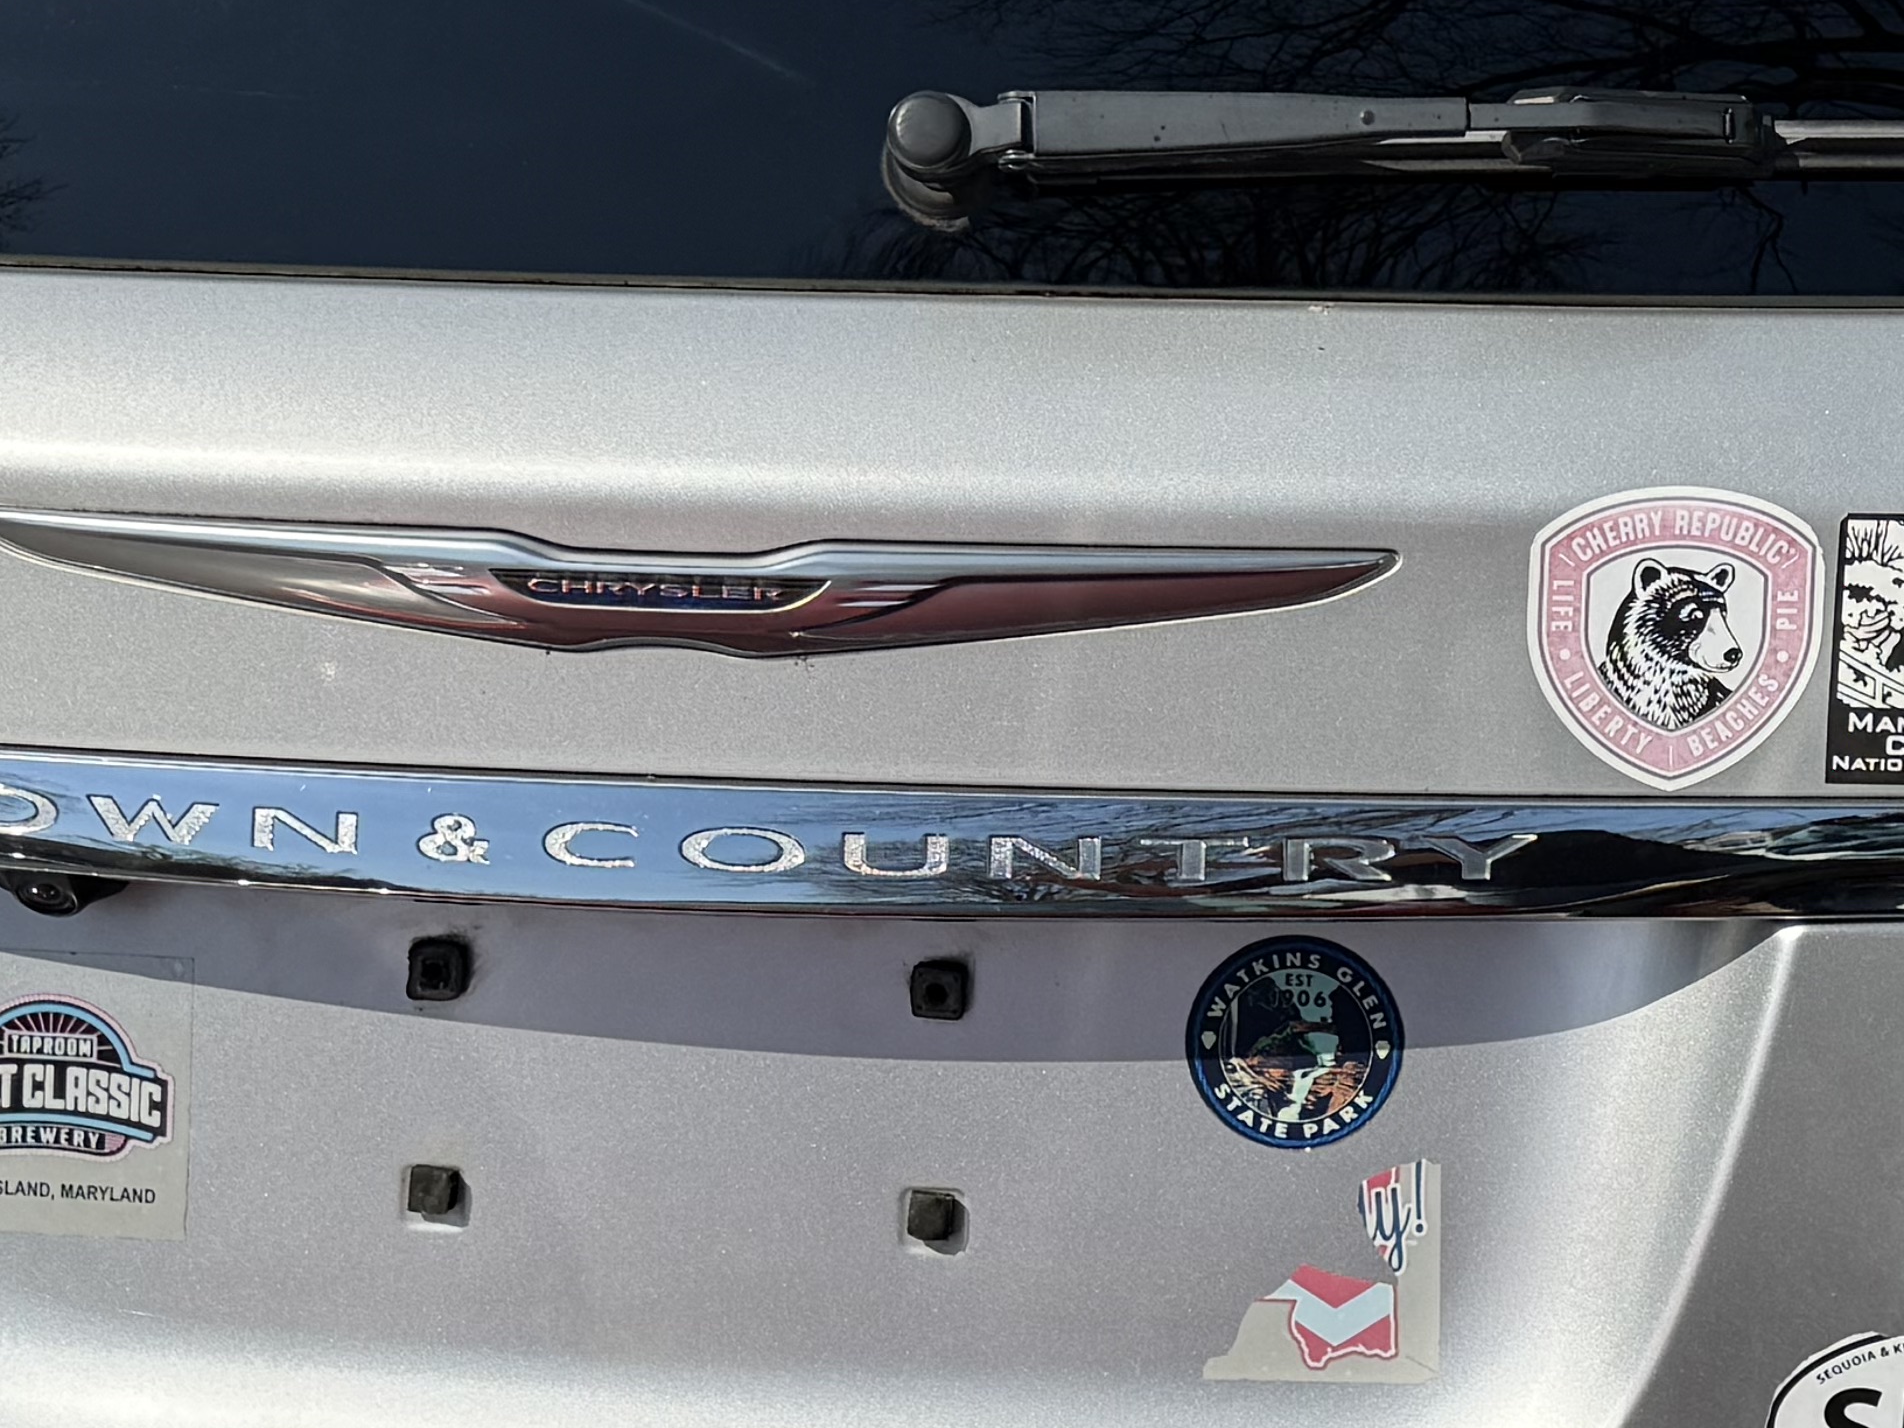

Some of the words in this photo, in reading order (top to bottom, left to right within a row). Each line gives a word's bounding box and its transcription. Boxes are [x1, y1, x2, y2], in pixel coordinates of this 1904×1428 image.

[1569, 508, 1664, 563] CHERRY
[1674, 508, 1790, 566] REPUBLIC
[526, 576, 787, 602] CHRYSLER
[1551, 579, 1576, 633] LIFE
[1775, 588, 1800, 631] PIE
[1563, 670, 1653, 756] LIBERTY
[1686, 671, 1780, 757] BEACHES
[416, 812, 492, 866] &
[540, 821, 1541, 882] COUNTRY
[1205, 951, 1323, 1019] WATKINS
[1335, 966, 1388, 1031] GLEN
[1284, 973, 1314, 988] EST
[10, 1034, 95, 1059] TAPROOM
[21, 1063, 163, 1129] CLASSIC
[1213, 1081, 1290, 1140] STATE
[1301, 1088, 1375, 1140] PARK
[60, 1183, 157, 1205] MARYLAND
[1815, 1349, 1877, 1386] SEQUOIA
[1880, 1346, 1890, 1358] &
